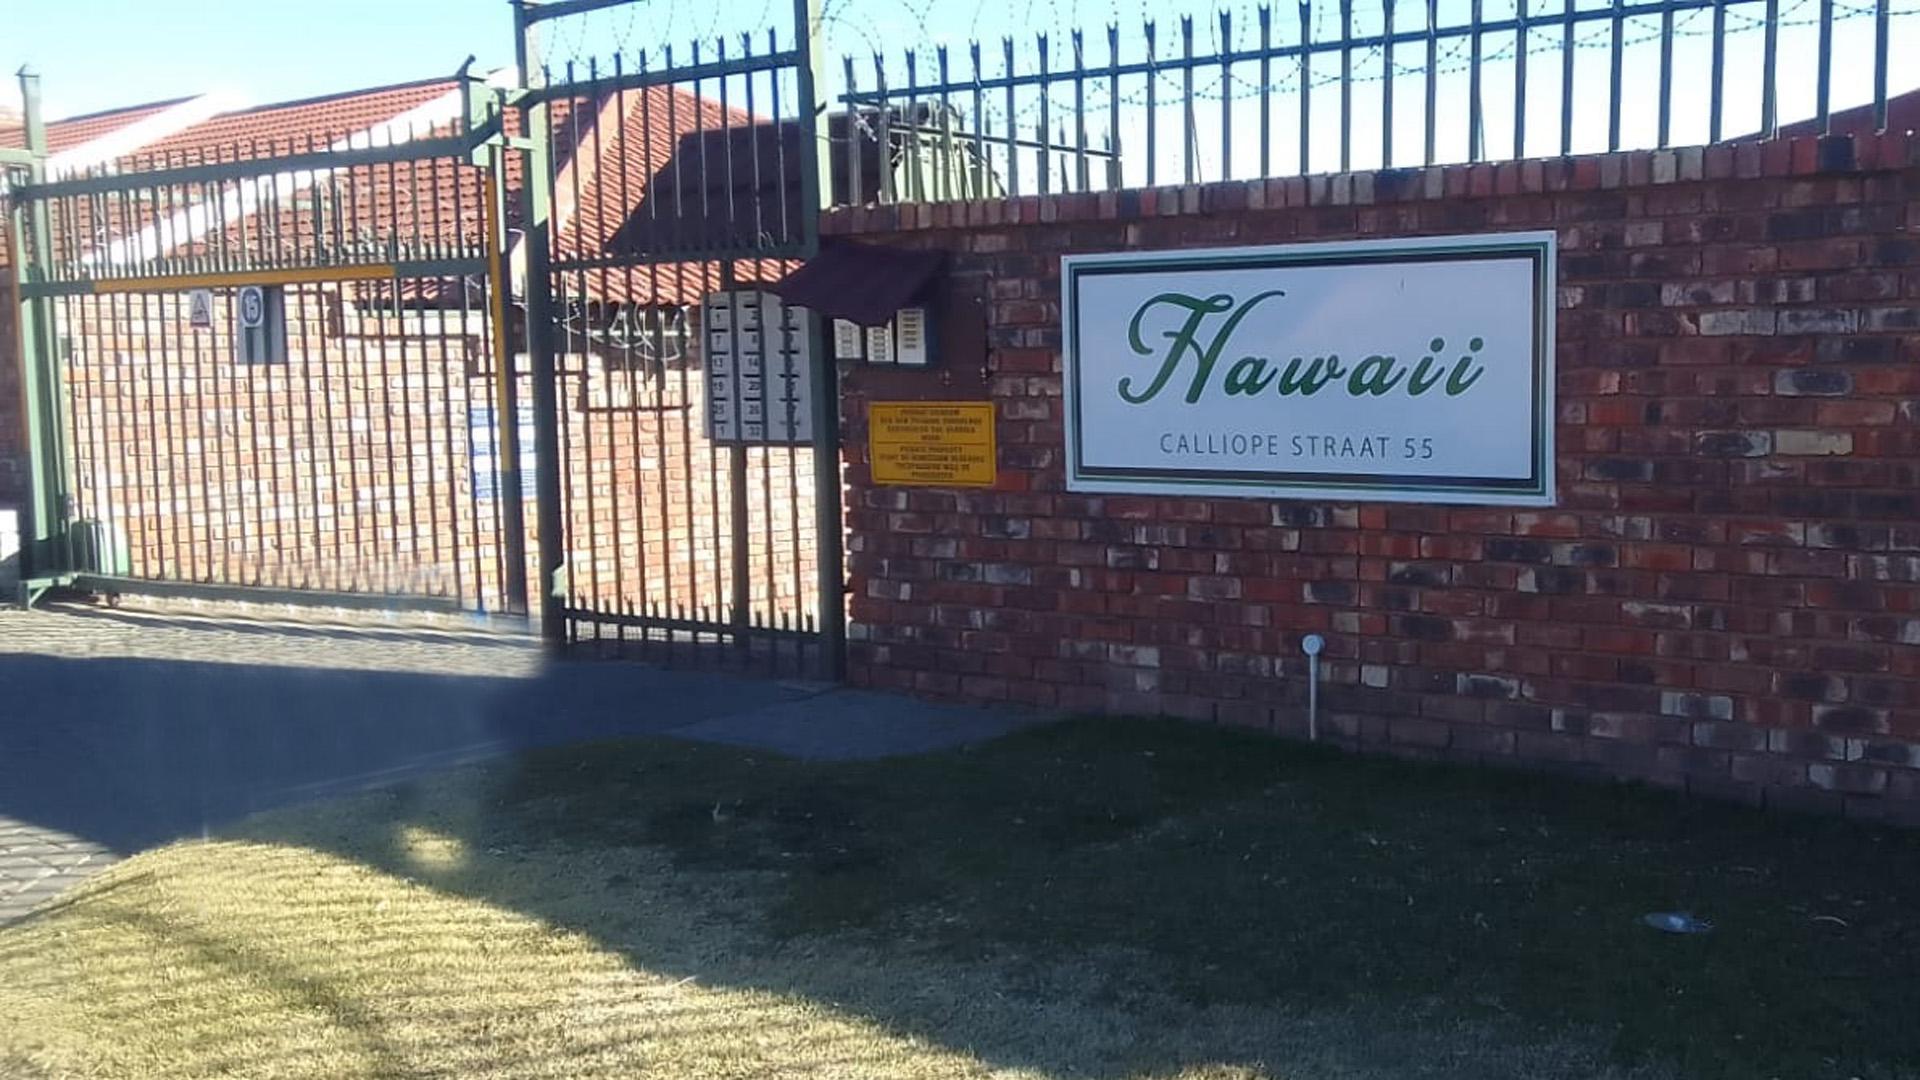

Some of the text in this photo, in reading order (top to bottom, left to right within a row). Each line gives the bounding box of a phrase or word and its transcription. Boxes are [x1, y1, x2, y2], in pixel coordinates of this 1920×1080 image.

[1118, 290, 1485, 405] Hawaii
[1159, 432, 1434, 459] CALLIOPE STRAAT 55
